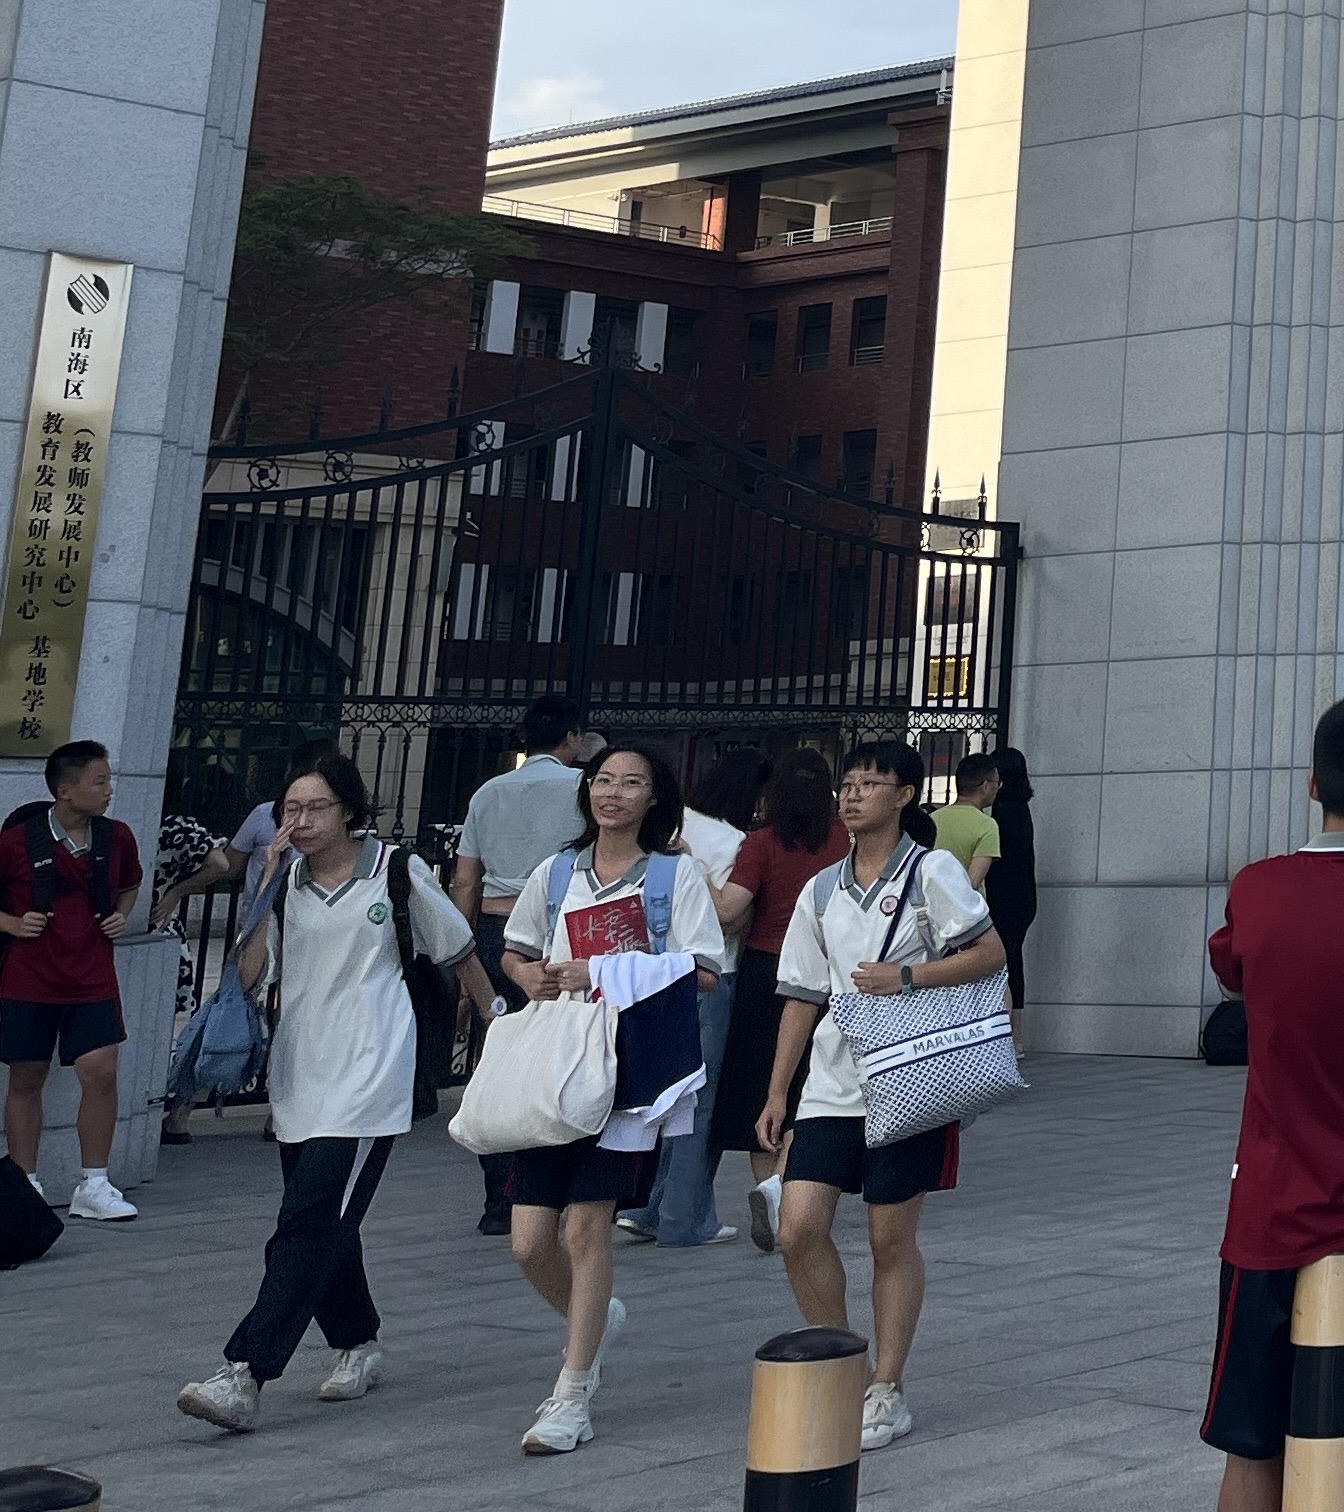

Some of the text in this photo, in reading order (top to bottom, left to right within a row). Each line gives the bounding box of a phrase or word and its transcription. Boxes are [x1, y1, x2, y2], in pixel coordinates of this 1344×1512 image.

[62, 325, 95, 402] 南海区
[16, 410, 64, 621] 教育发展研究中心
[16, 634, 52, 740] 基地学校
[912, 1026, 985, 1055] MARVALAS
